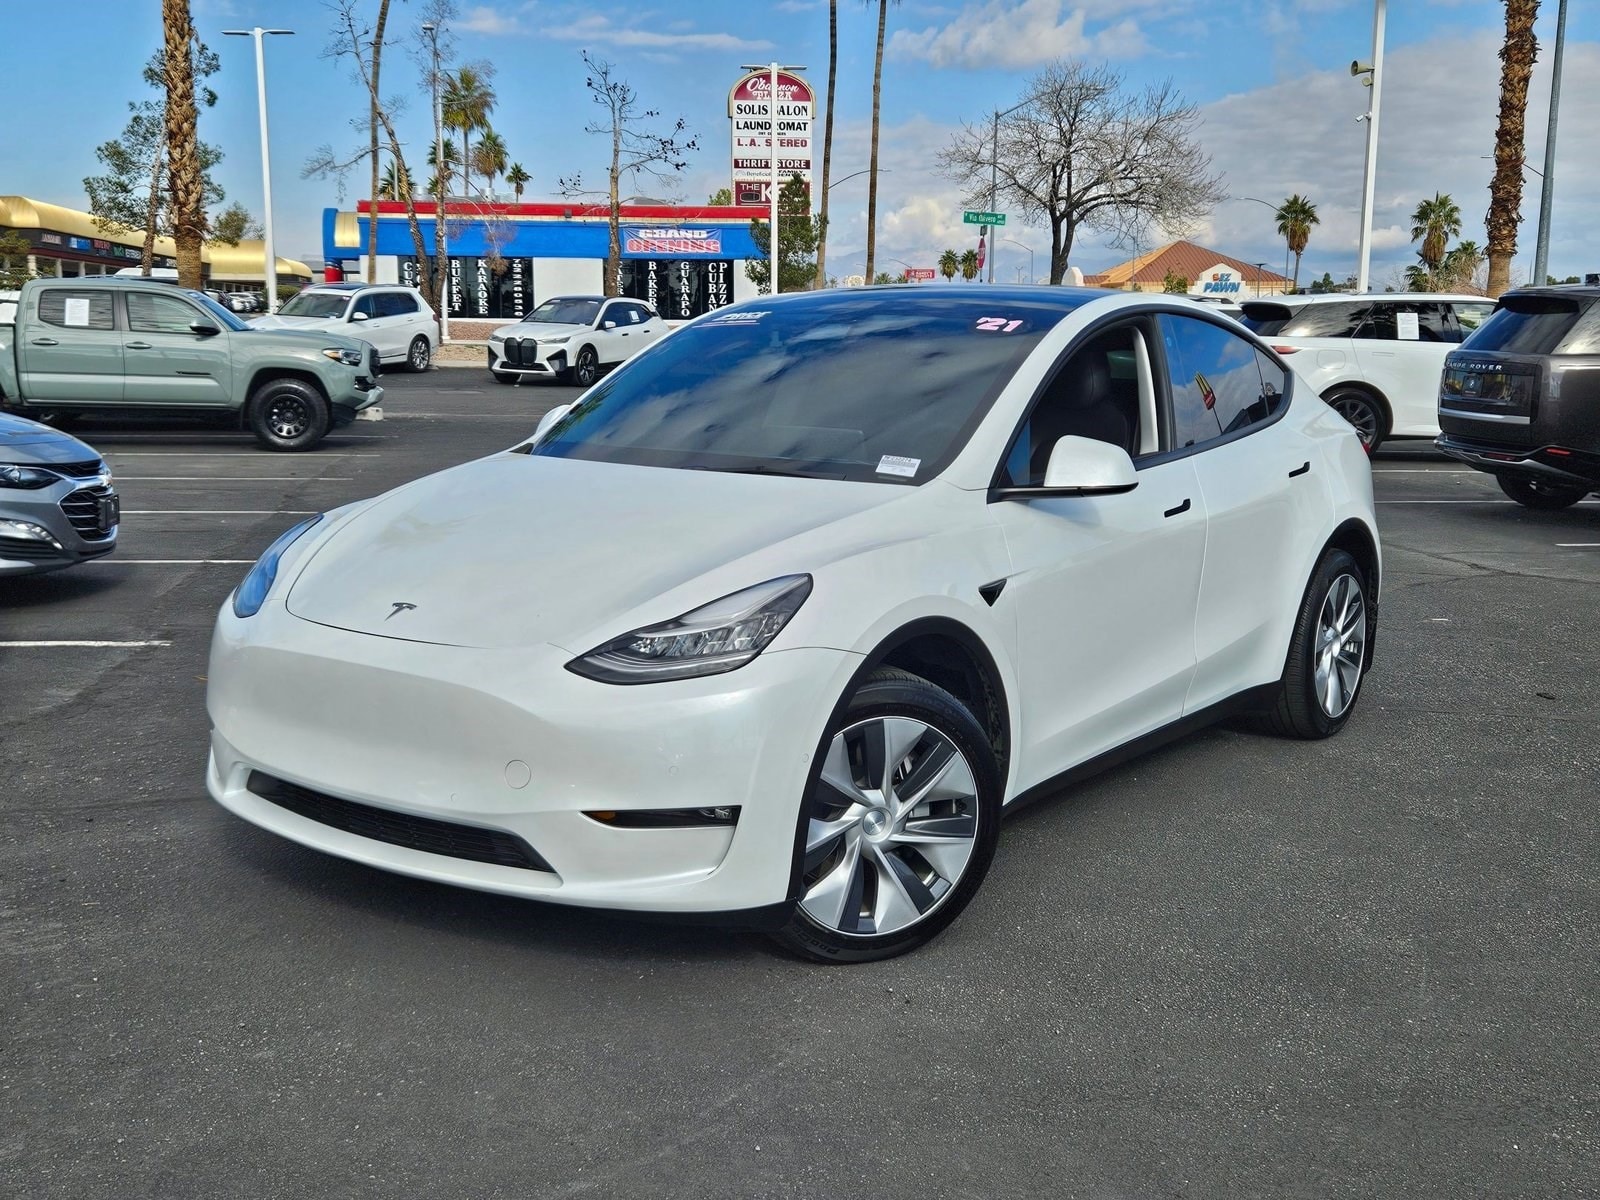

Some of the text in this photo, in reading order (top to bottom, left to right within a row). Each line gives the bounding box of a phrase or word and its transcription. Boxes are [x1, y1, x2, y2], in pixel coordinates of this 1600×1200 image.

[746, 77, 799, 92] O'banon
[752, 91, 792, 100] PLZA
[736, 104, 808, 116] SOLIS ALON
[736, 121, 809, 131] LAUNDOMAT
[737, 138, 808, 148] L.A. SEREO
[738, 159, 806, 168] THRIFT STORE
[740, 183, 760, 191] THE
[639, 229, 707, 239] GRAND
[627, 239, 720, 253] OPENING
[451, 259, 462, 311] BUFFET
[477, 259, 489, 314] KARAOKE
[680, 261, 691, 317] GUARAPO
[708, 262, 718, 311] CUBAN
[719, 262, 728, 305] PIZZ
[1203, 282, 1240, 293] PAWN
[976, 316, 1023, 332] 21
[1470, 363, 1502, 371] ROVER
